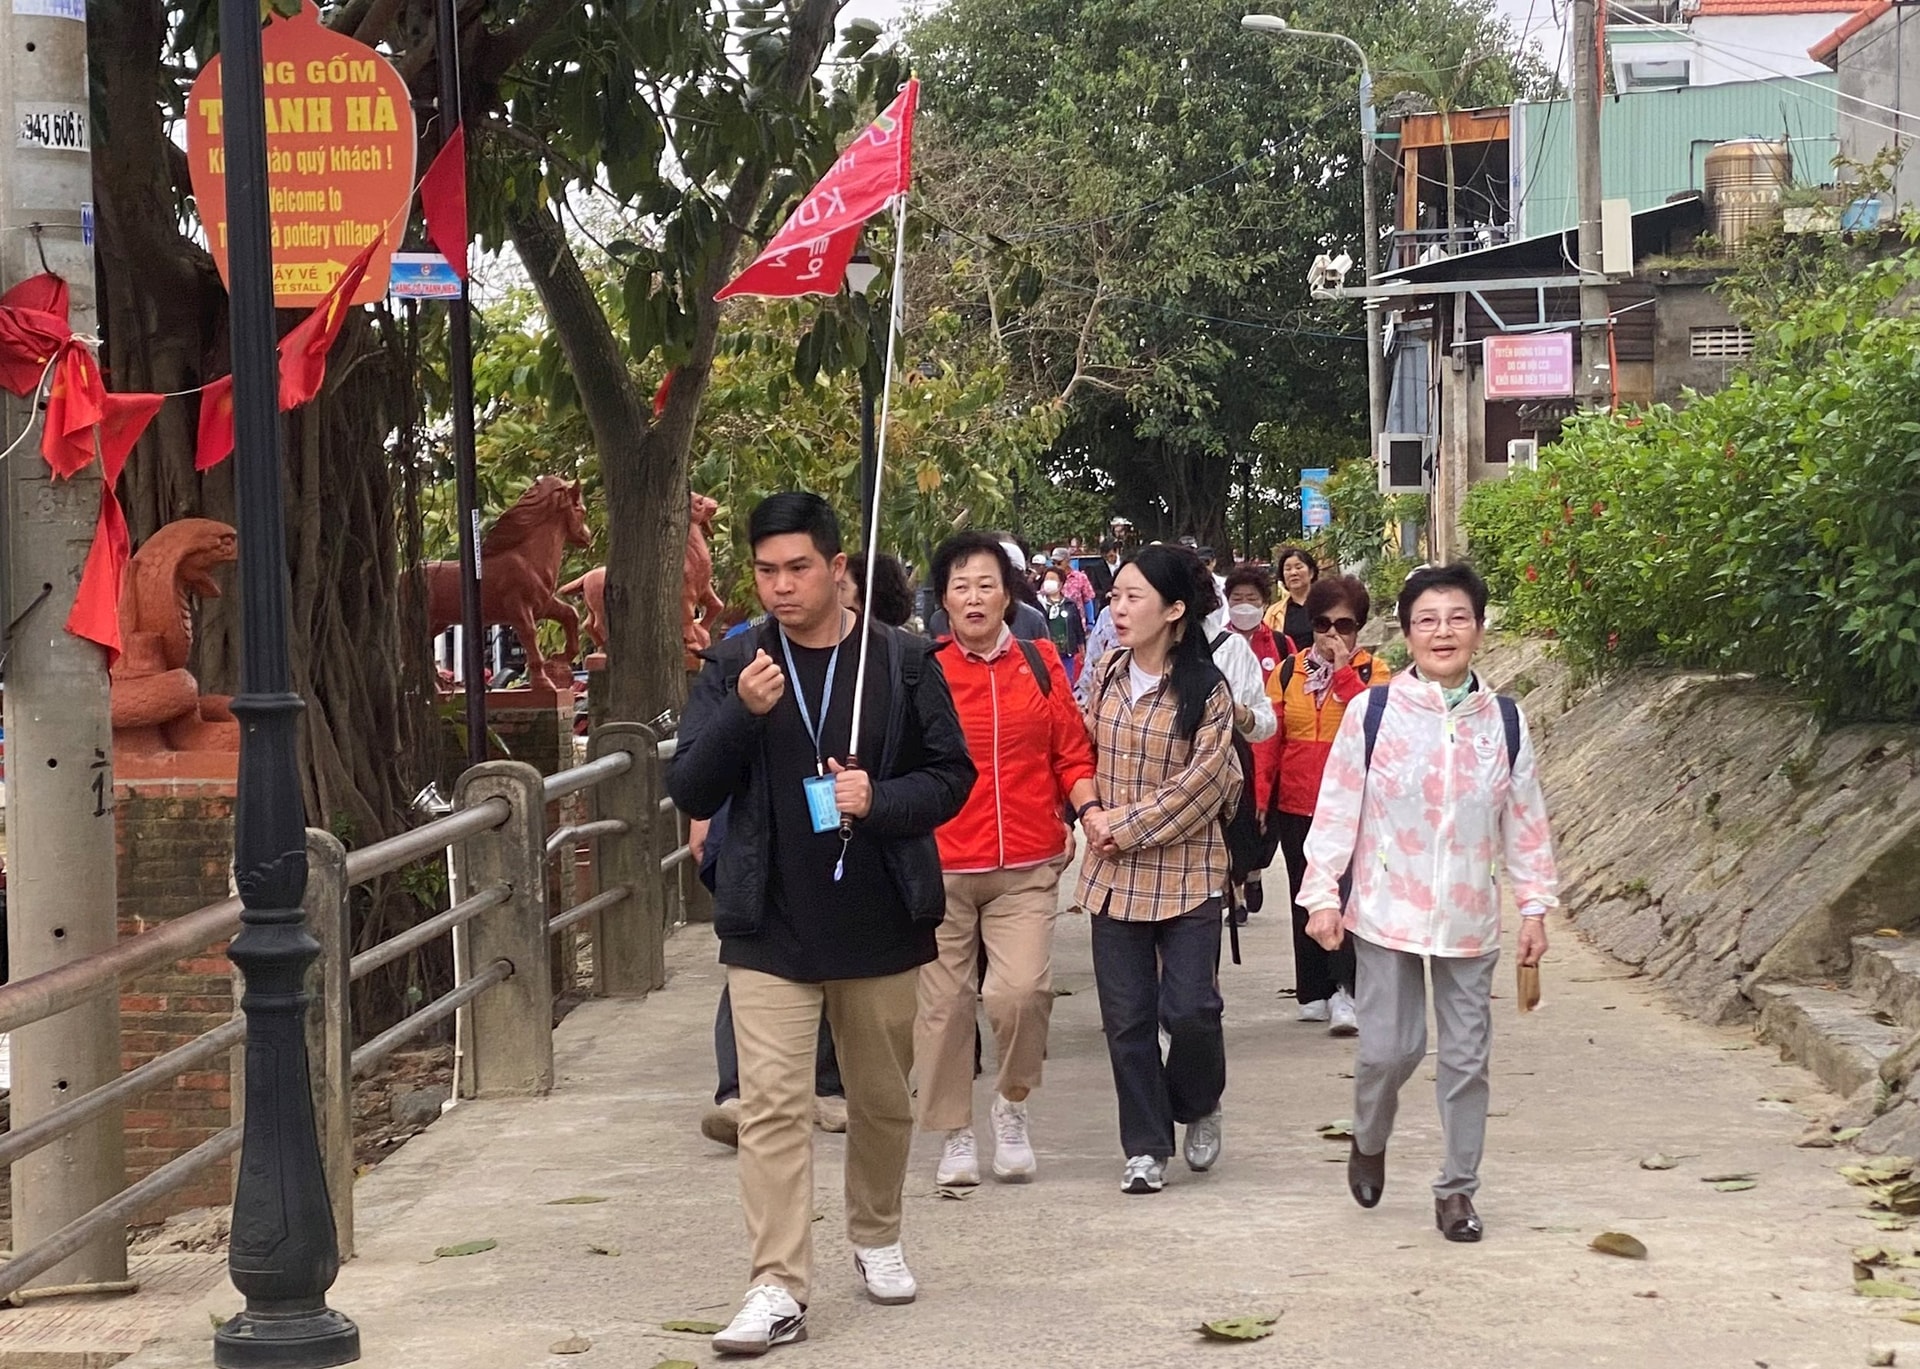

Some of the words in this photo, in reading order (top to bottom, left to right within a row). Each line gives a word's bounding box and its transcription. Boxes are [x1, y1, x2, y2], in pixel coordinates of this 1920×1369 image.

[307, 52, 376, 84] GỐM
[199, 97, 333, 134] TANH
[346, 87, 398, 132] HÀ
[297, 145, 325, 175] quý
[331, 145, 381, 171] khách
[328, 186, 342, 212] to
[284, 221, 330, 249] pottery
[334, 220, 379, 247] village
[299, 266, 318, 279] VÉ
[290, 283, 322, 292] STALL
